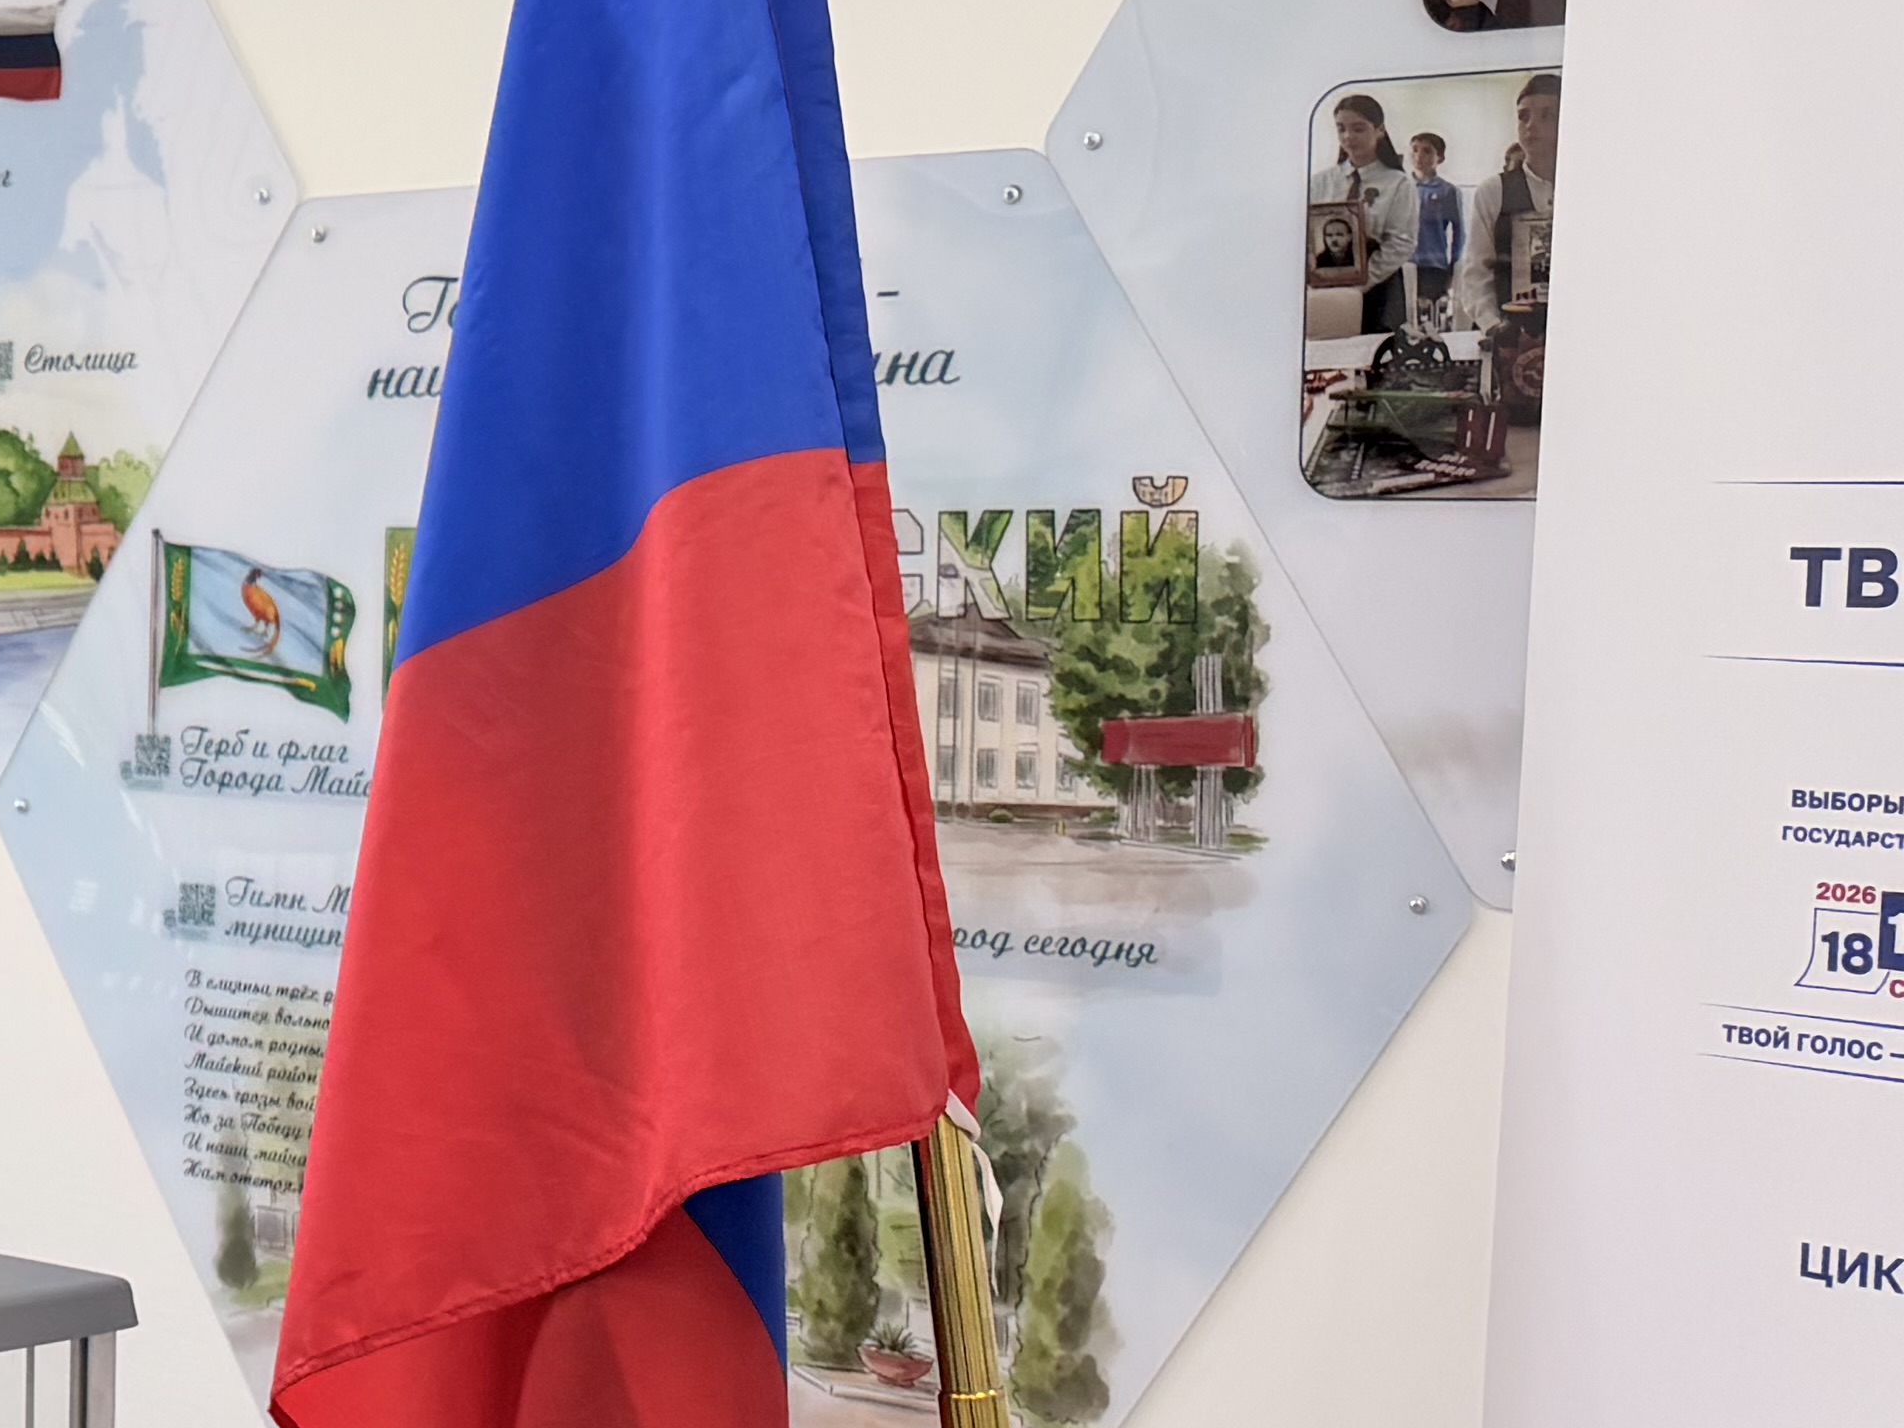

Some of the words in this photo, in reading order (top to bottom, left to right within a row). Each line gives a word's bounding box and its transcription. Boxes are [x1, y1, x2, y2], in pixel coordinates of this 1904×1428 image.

[24, 344, 138, 374] Столица
[180, 725, 250, 762] Герб
[252, 740, 269, 760] и
[277, 738, 349, 766] флаг
[179, 757, 284, 797] Города
[225, 876, 307, 911] Гимн
[1815, 882, 1877, 904] 2026
[1024, 932, 1158, 968] сегодня
[1821, 931, 1874, 975] 18
[268, 1040, 324, 1058] родны
[1722, 1024, 1790, 1050] ТВОЙ
[1797, 1033, 1883, 1061] ГОЛОС
[185, 1052, 263, 1077] Майский
